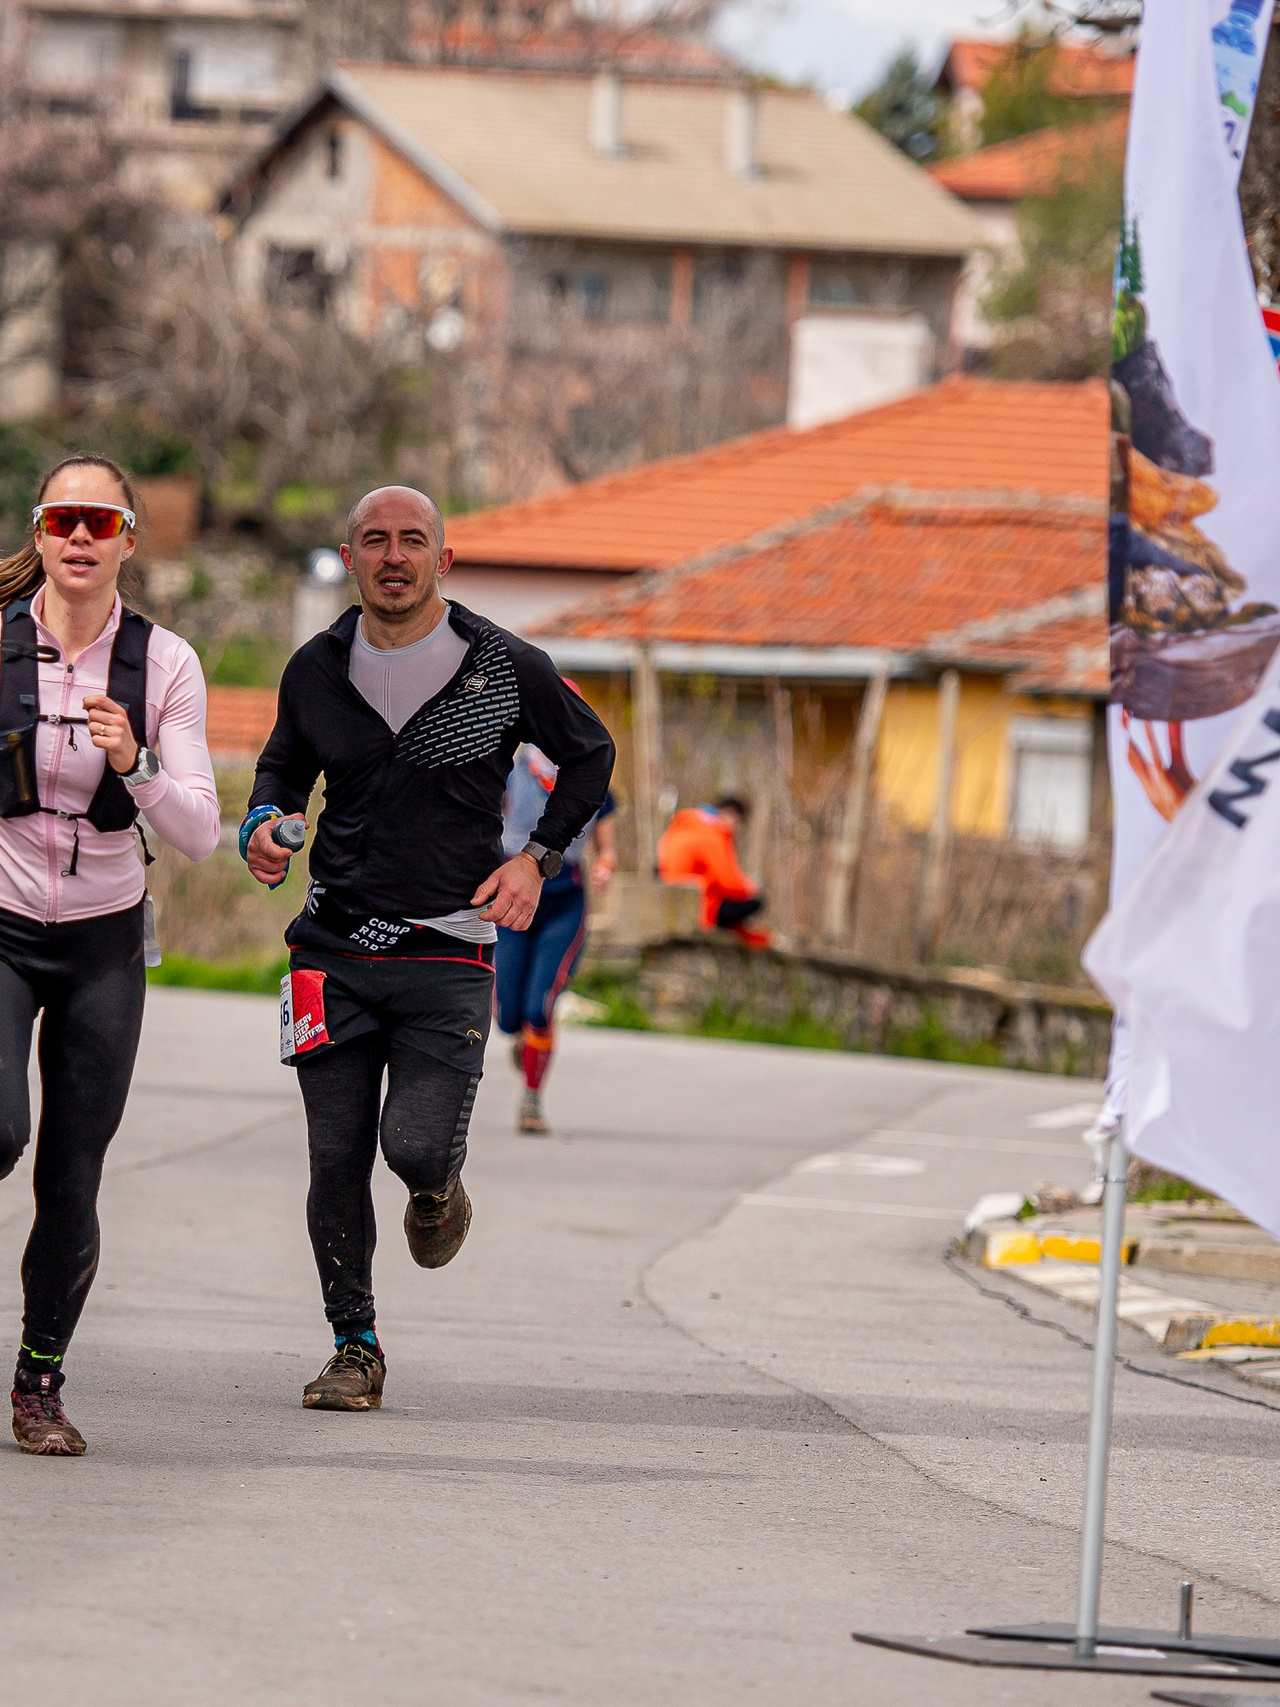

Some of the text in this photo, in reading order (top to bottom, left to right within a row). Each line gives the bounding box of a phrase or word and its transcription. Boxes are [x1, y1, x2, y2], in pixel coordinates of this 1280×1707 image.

[358, 925, 399, 945] RESS
[368, 917, 411, 935] COMP
[349, 932, 392, 951] POR
[294, 1023, 310, 1040] STEP
